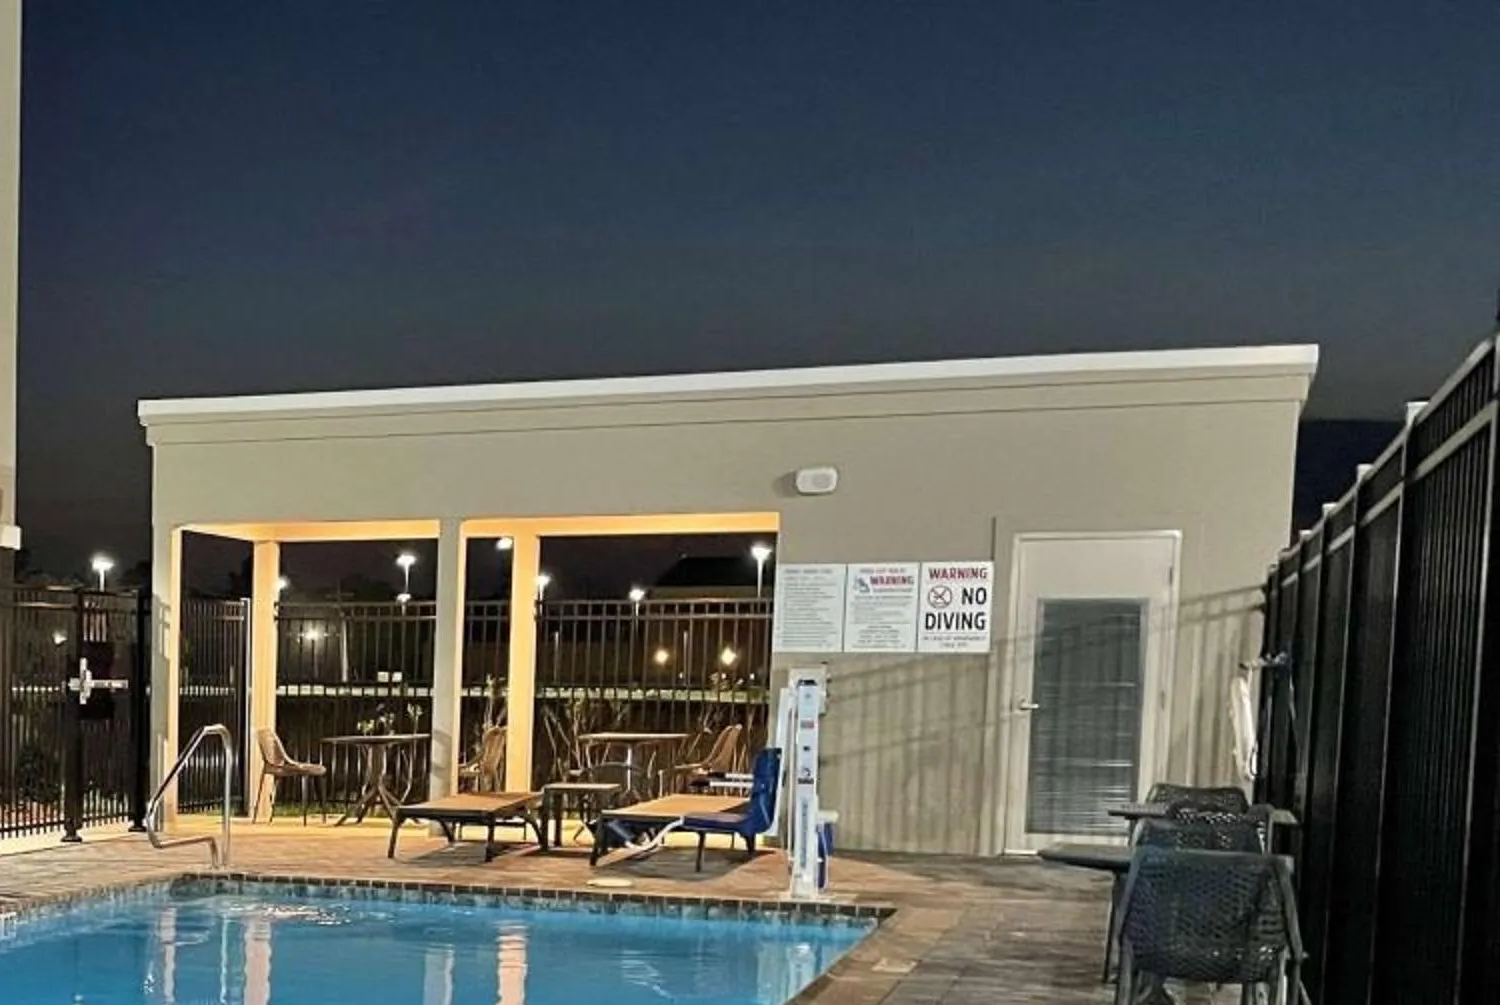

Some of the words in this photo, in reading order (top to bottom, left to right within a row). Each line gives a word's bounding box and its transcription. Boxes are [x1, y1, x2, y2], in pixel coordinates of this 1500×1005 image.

[870, 575, 914, 585] WARNING
[928, 567, 988, 580] WARNING
[961, 587, 987, 605] NO
[925, 612, 986, 631] DIVING
